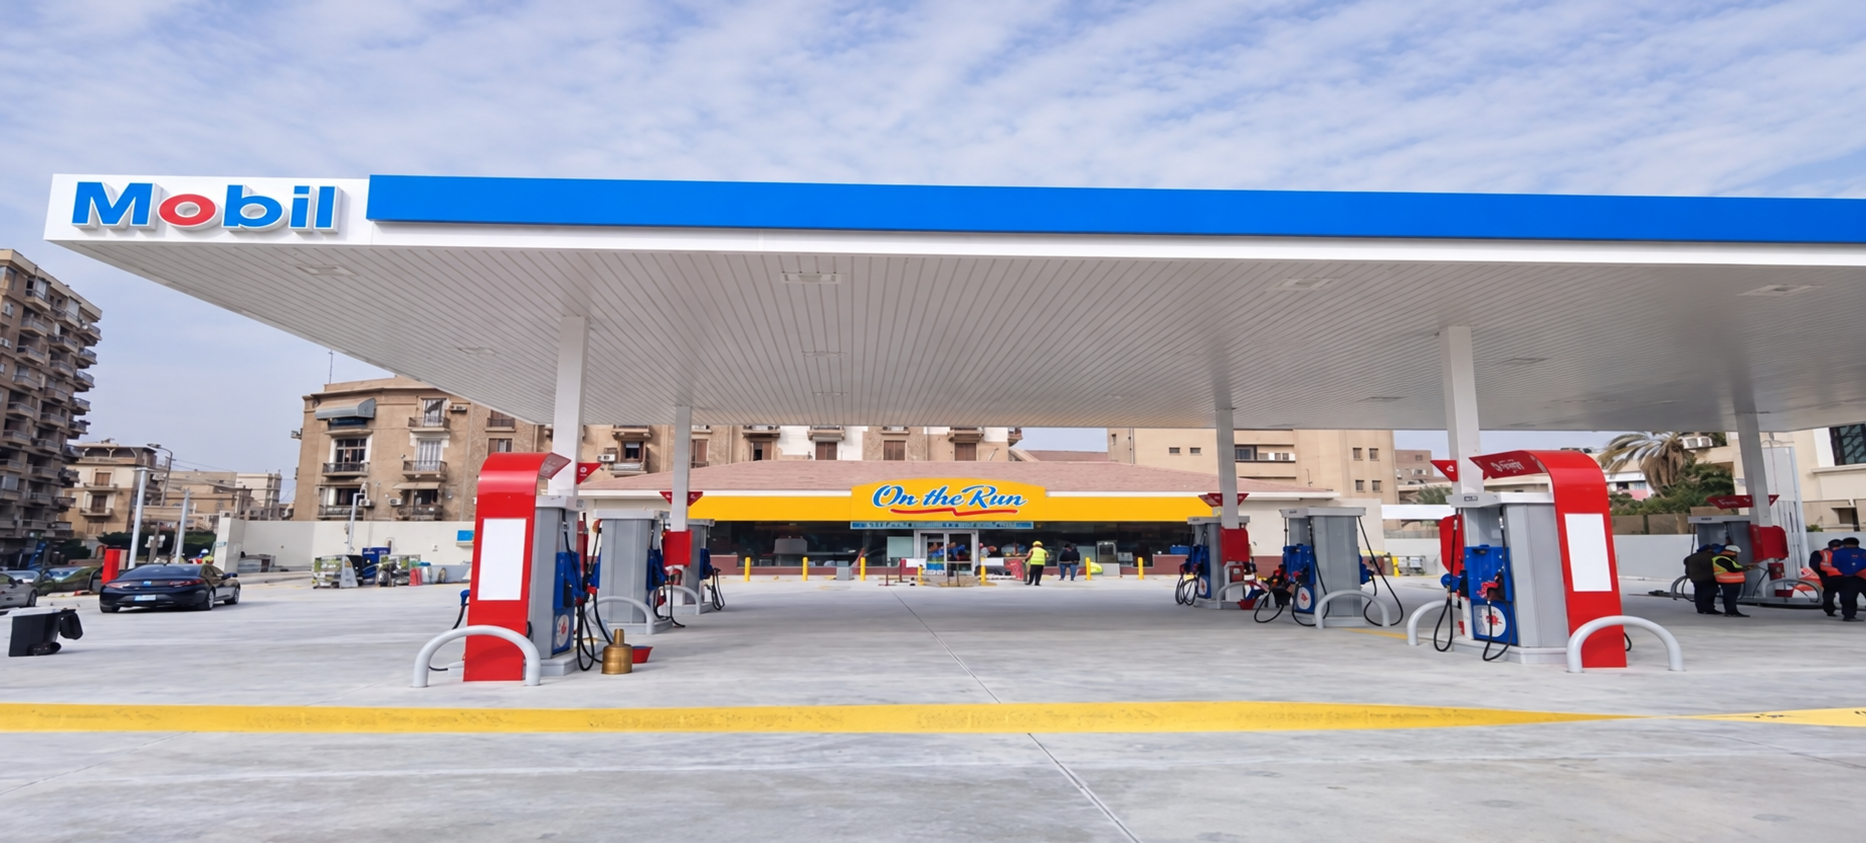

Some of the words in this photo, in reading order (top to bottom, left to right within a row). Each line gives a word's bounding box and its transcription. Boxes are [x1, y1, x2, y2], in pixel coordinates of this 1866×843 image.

[71, 181, 337, 230] Mobil
[872, 484, 918, 507] On
[922, 485, 965, 507] the
[961, 484, 1028, 509] Run
